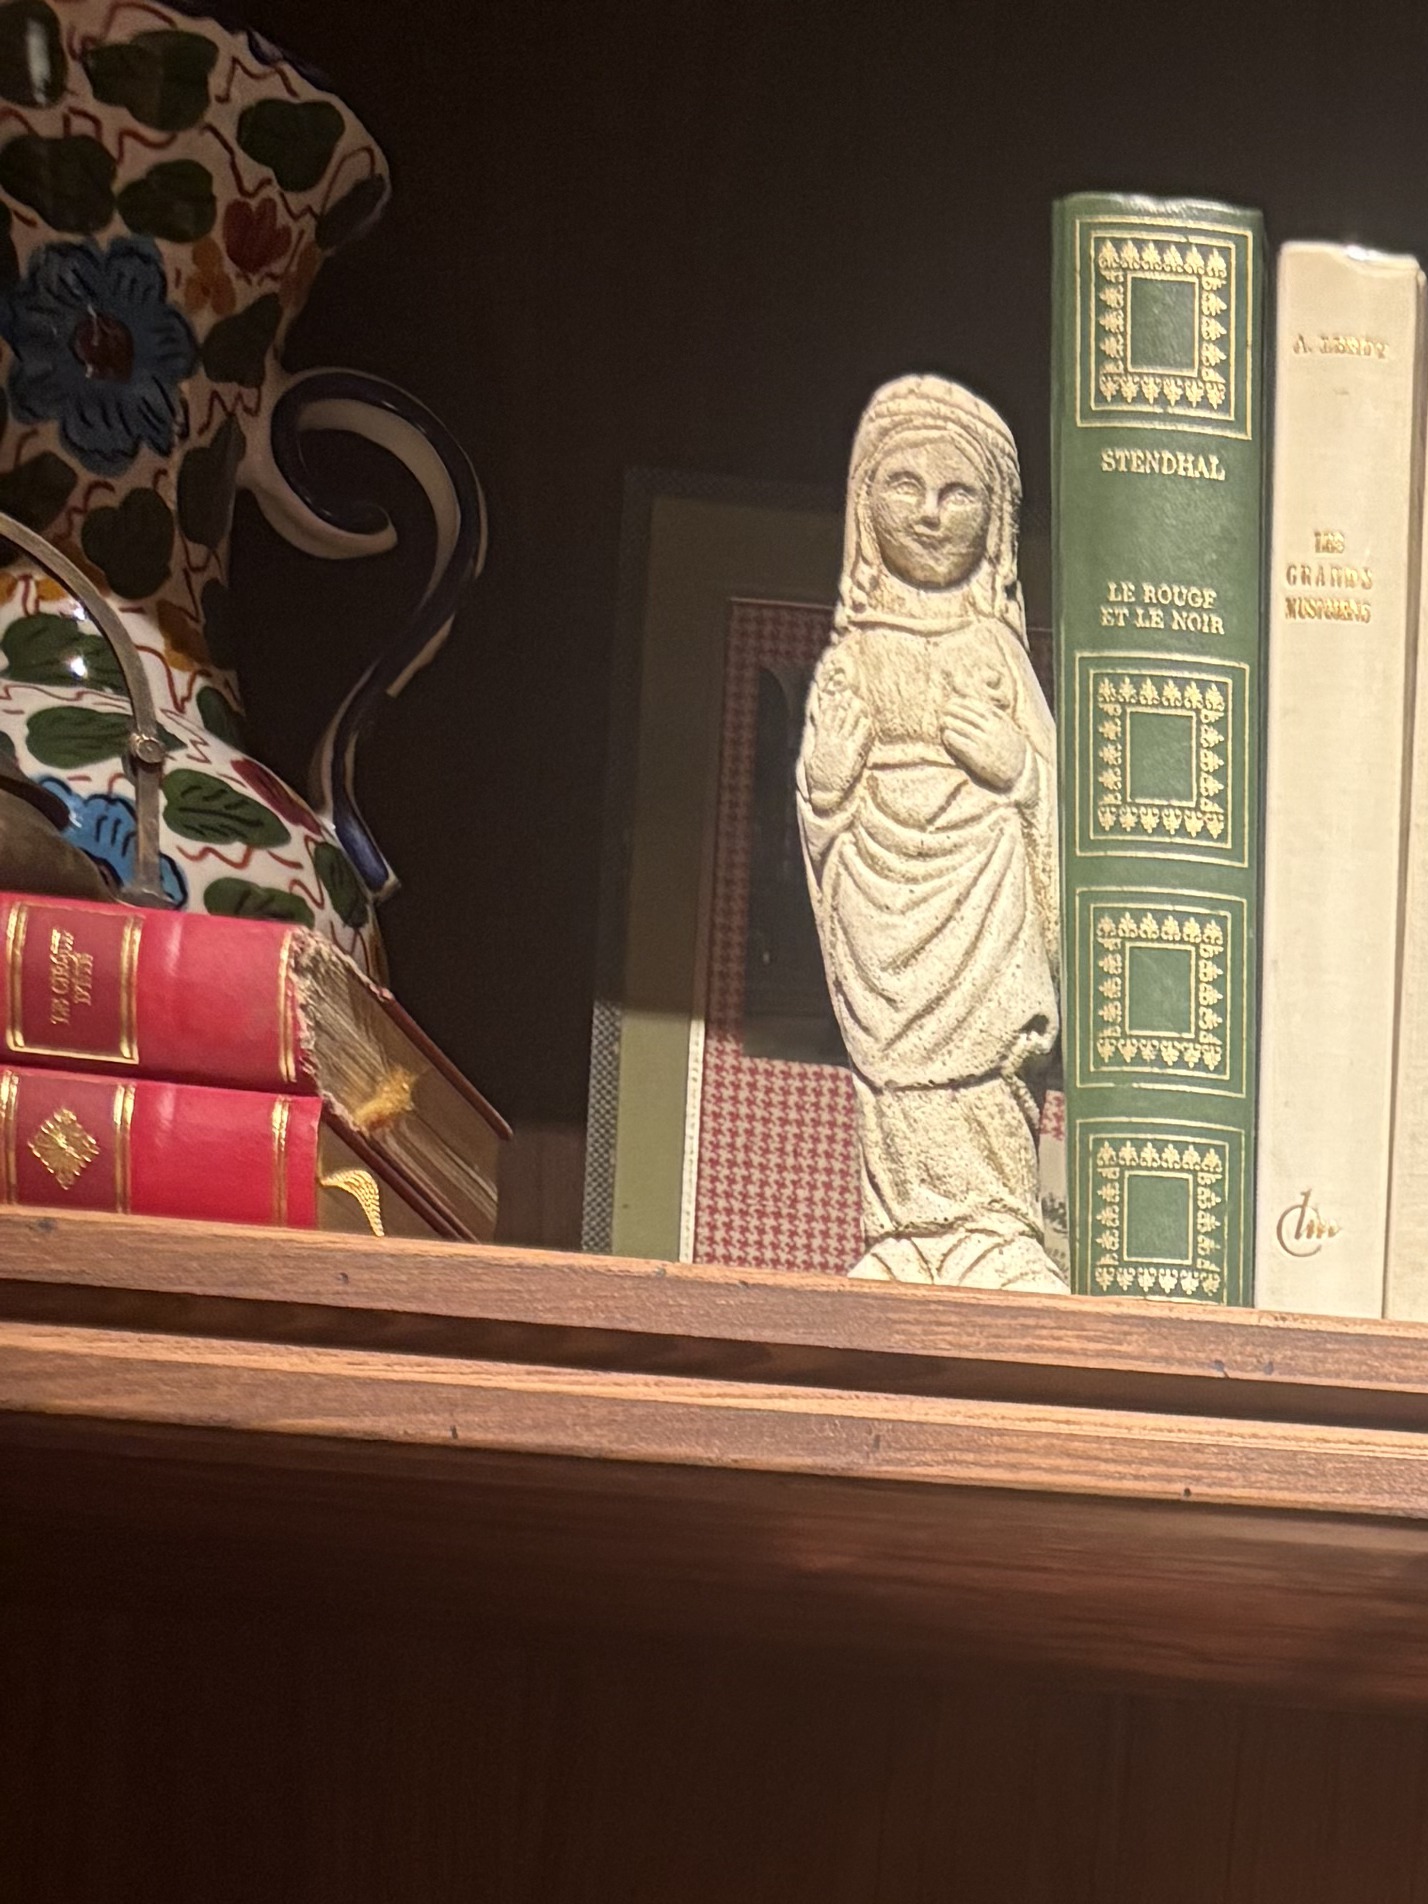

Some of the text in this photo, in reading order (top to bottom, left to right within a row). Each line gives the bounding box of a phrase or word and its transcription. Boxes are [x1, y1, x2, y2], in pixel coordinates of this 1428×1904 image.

[1100, 446, 1226, 482] STENDHAL
[1286, 563, 1373, 590] GRANDS
[1106, 581, 1218, 610] LE ROUGE
[1101, 605, 1225, 635] ET LE NOIR
